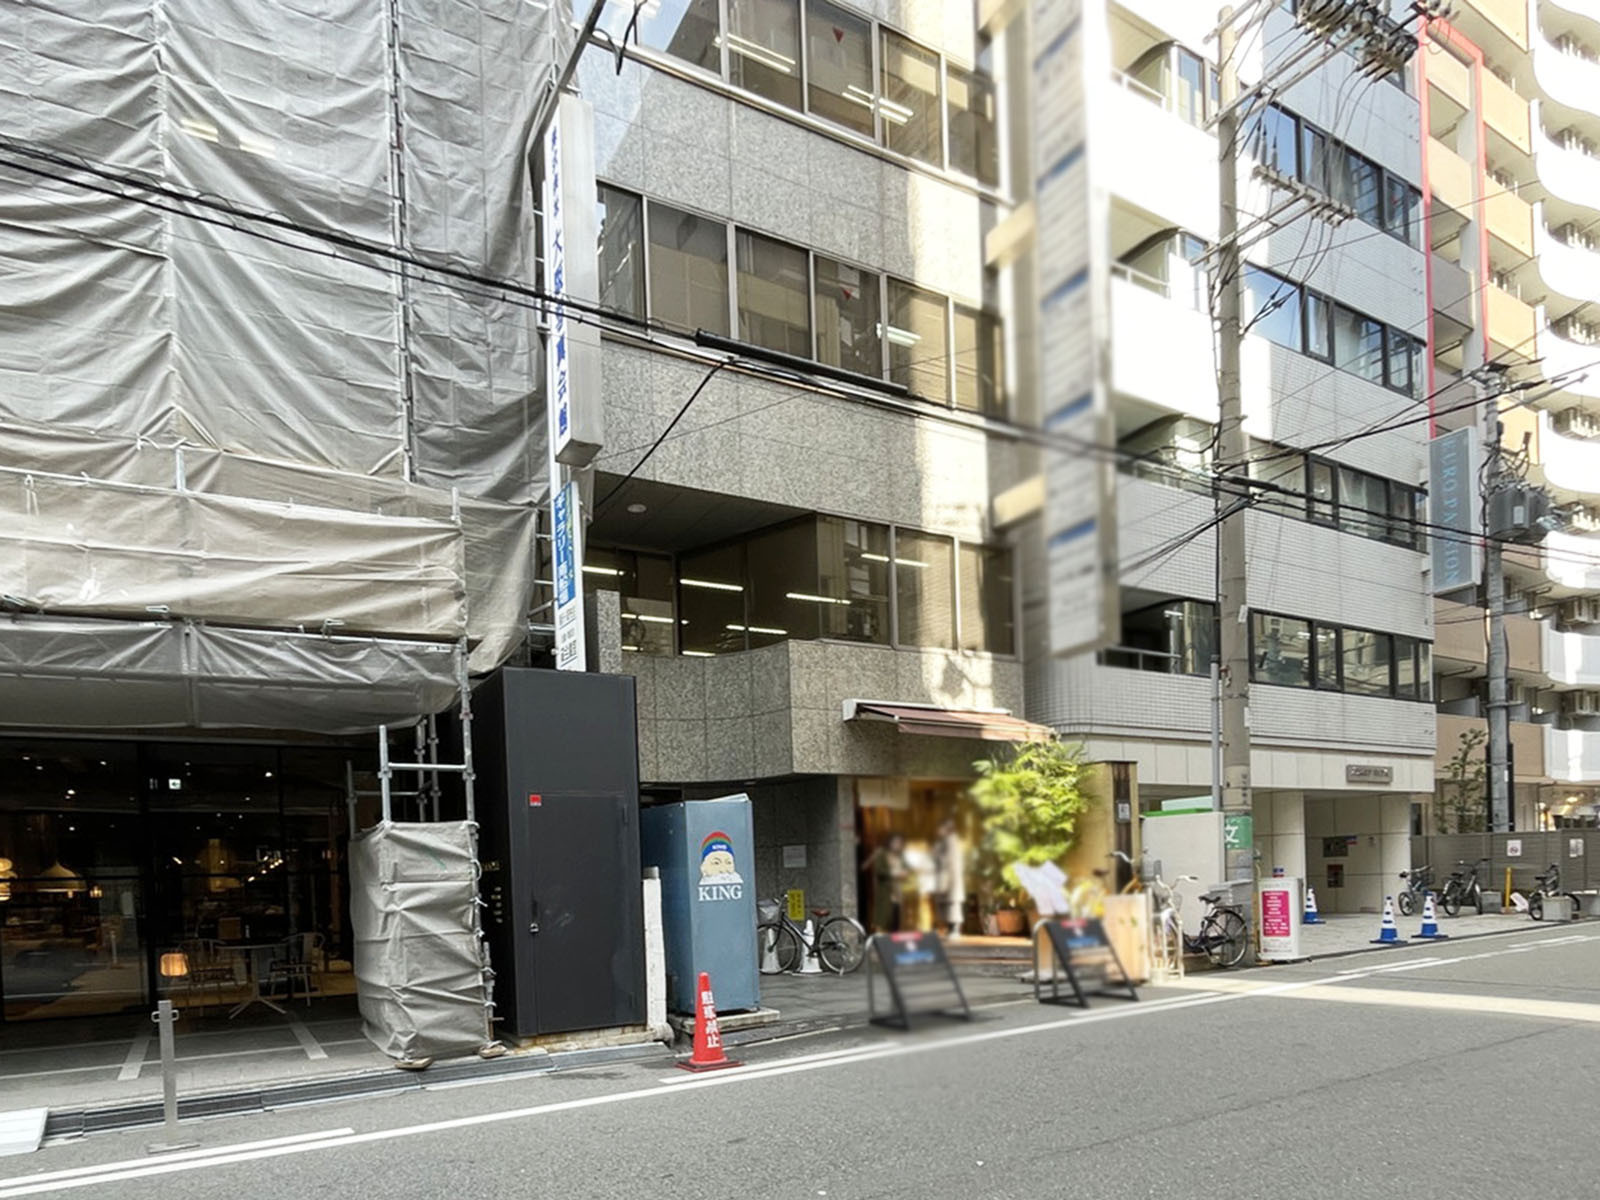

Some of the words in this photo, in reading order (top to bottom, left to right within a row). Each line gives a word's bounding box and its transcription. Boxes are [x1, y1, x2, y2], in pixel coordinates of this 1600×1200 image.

[698, 884, 742, 901] KING
[701, 991, 721, 1049] 駐車禁止
